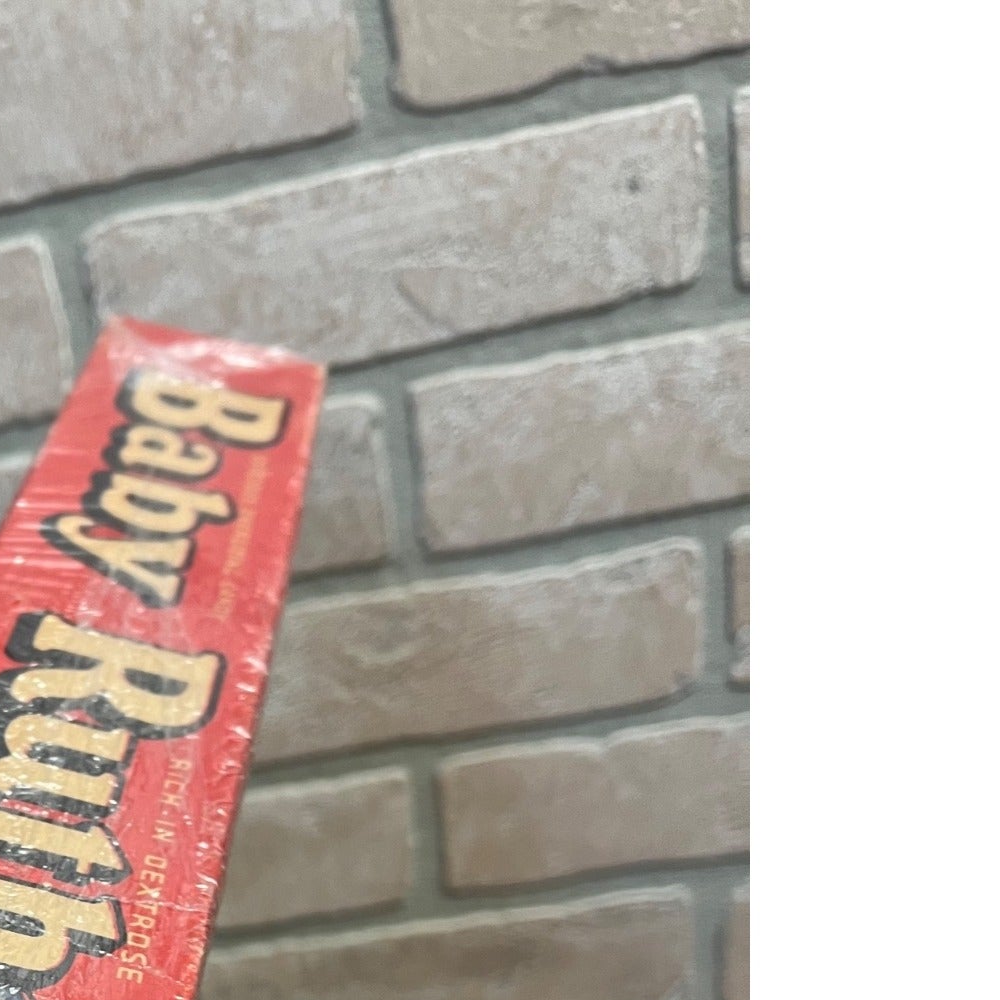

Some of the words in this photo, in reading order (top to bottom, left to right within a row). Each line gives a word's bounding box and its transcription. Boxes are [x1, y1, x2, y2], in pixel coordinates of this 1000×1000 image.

[54, 370, 288, 602] Baby
[160, 757, 192, 808] RICH
[151, 820, 177, 844] IN
[115, 854, 169, 985] DEXTROSE
